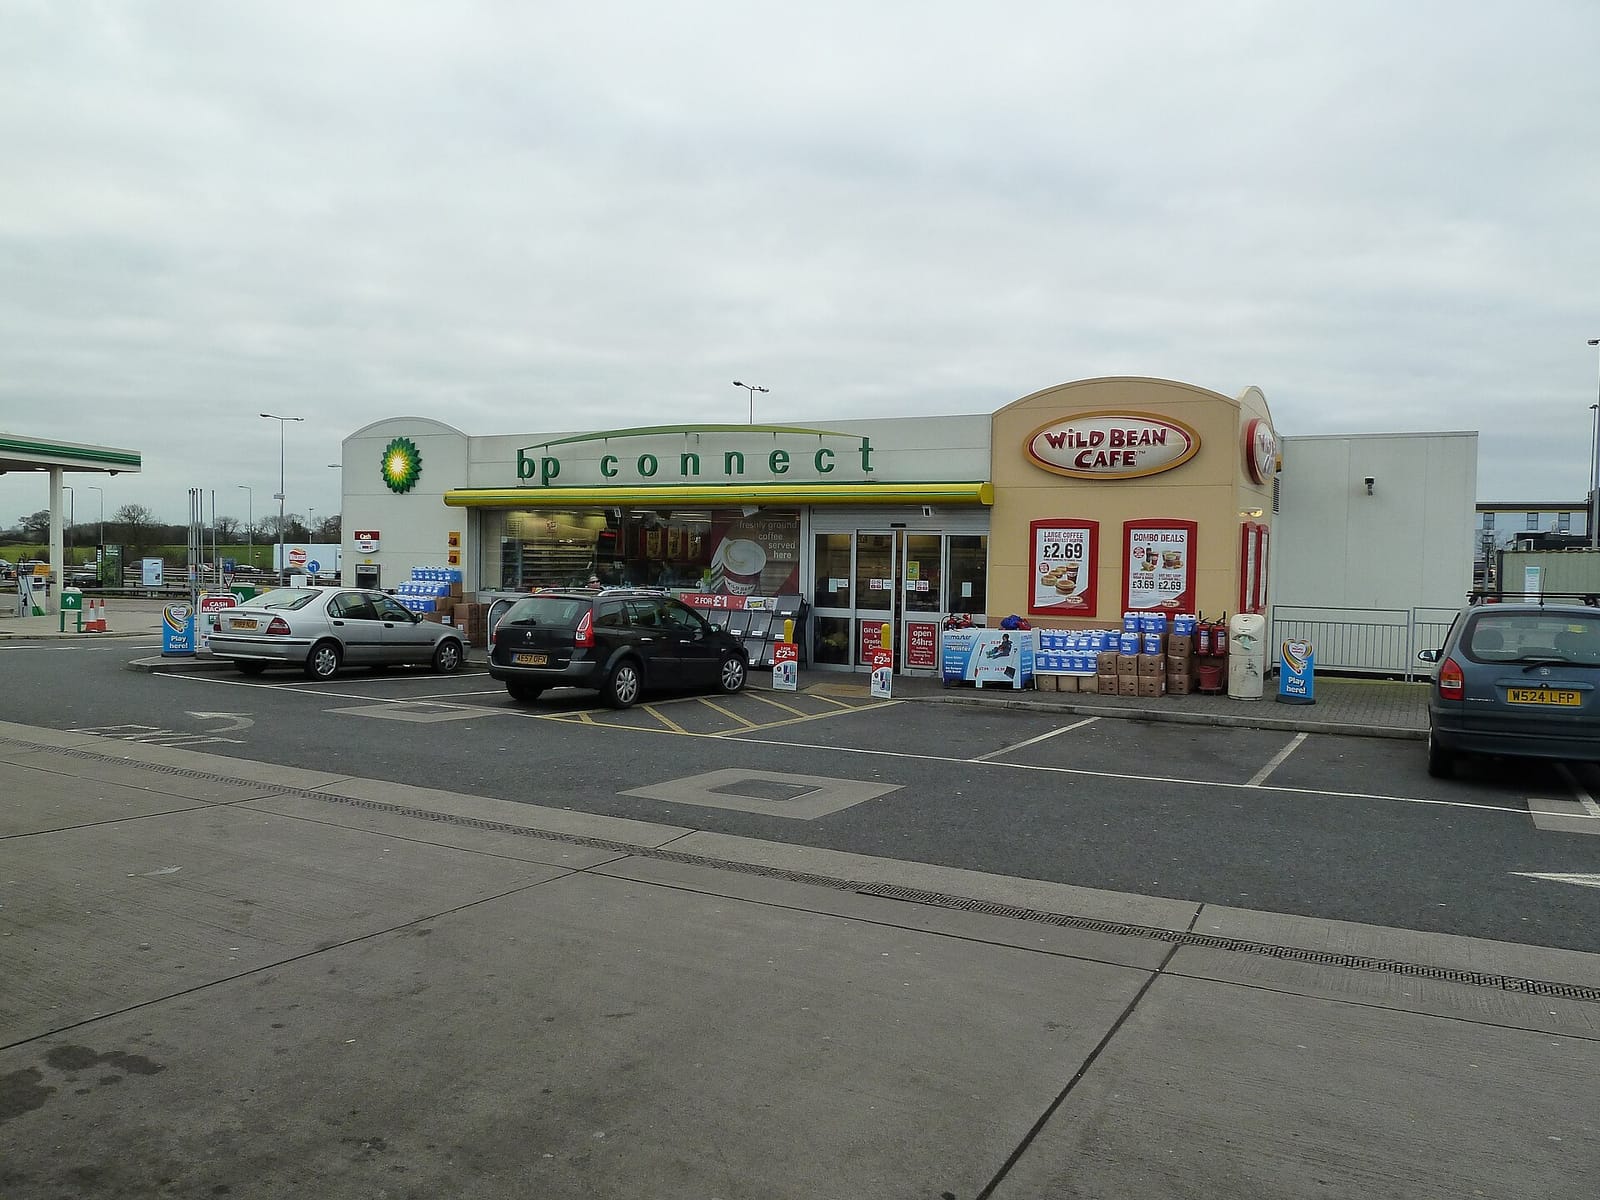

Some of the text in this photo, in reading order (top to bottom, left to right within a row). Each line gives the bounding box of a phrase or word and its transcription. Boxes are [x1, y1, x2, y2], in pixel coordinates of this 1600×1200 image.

[1109, 428, 1167, 448] BEAN
[517, 438, 874, 486] bp connect
[1074, 450, 1137, 468] CAFE
[739, 520, 797, 530] freshly ground
[759, 532, 783, 540] coffee
[1134, 534, 1185, 542] COMBO DEALS
[769, 541, 796, 549] served
[773, 550, 792, 559] here
[1043, 543, 1083, 559] £2.69
[1132, 580, 1155, 589] £3.69
[1158, 581, 1182, 590] £2.69
[713, 595, 728, 607] £1
[913, 630, 932, 638] open
[170, 635, 187, 643] Play
[911, 638, 933, 646] 24hrs
[1288, 676, 1305, 686] Play
[1286, 685, 1306, 693] here!
[1512, 691, 1575, 703] W524 LFP
